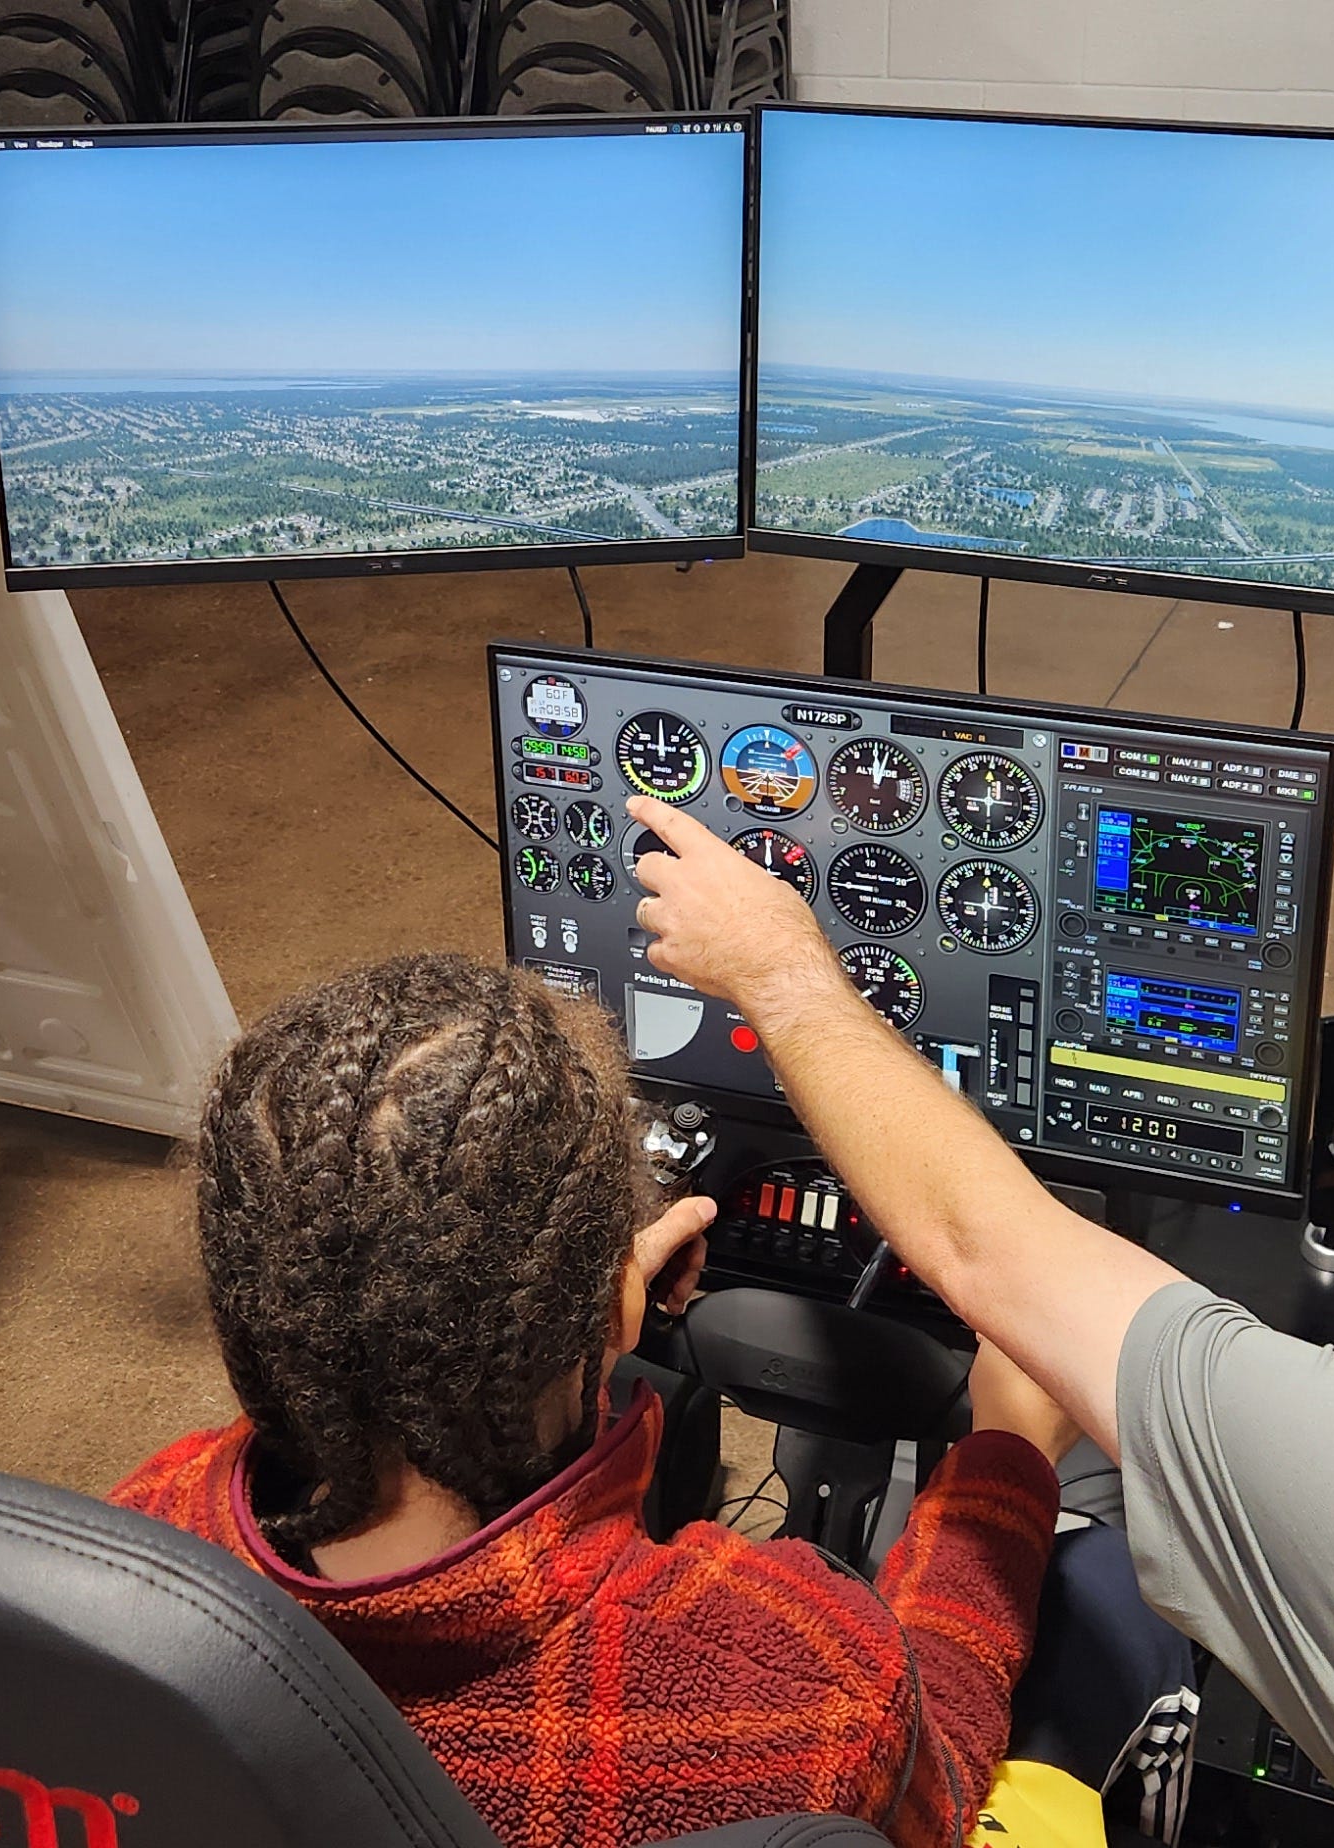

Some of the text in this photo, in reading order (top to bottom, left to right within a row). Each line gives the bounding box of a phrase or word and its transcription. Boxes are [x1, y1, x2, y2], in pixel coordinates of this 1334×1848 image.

[797, 709, 847, 725] N172SP
[1119, 751, 1141, 762] COM
[1171, 757, 1192, 768] NAV
[1118, 767, 1140, 777] COM
[1223, 764, 1243, 773] ADF
[1170, 774, 1190, 784] NAV
[1278, 770, 1300, 780] DME
[1222, 781, 1241, 791] ADF
[1276, 788, 1299, 798] MKR
[865, 860, 877, 868] 10
[895, 878, 907, 887] 20
[894, 899, 907, 908] 20
[864, 908, 876, 918] 10
[634, 972, 695, 991] Parking Bra
[1088, 1083, 1107, 1093] NAV
[1156, 1095, 1175, 1105] REV
[1192, 1101, 1210, 1111] ALT
